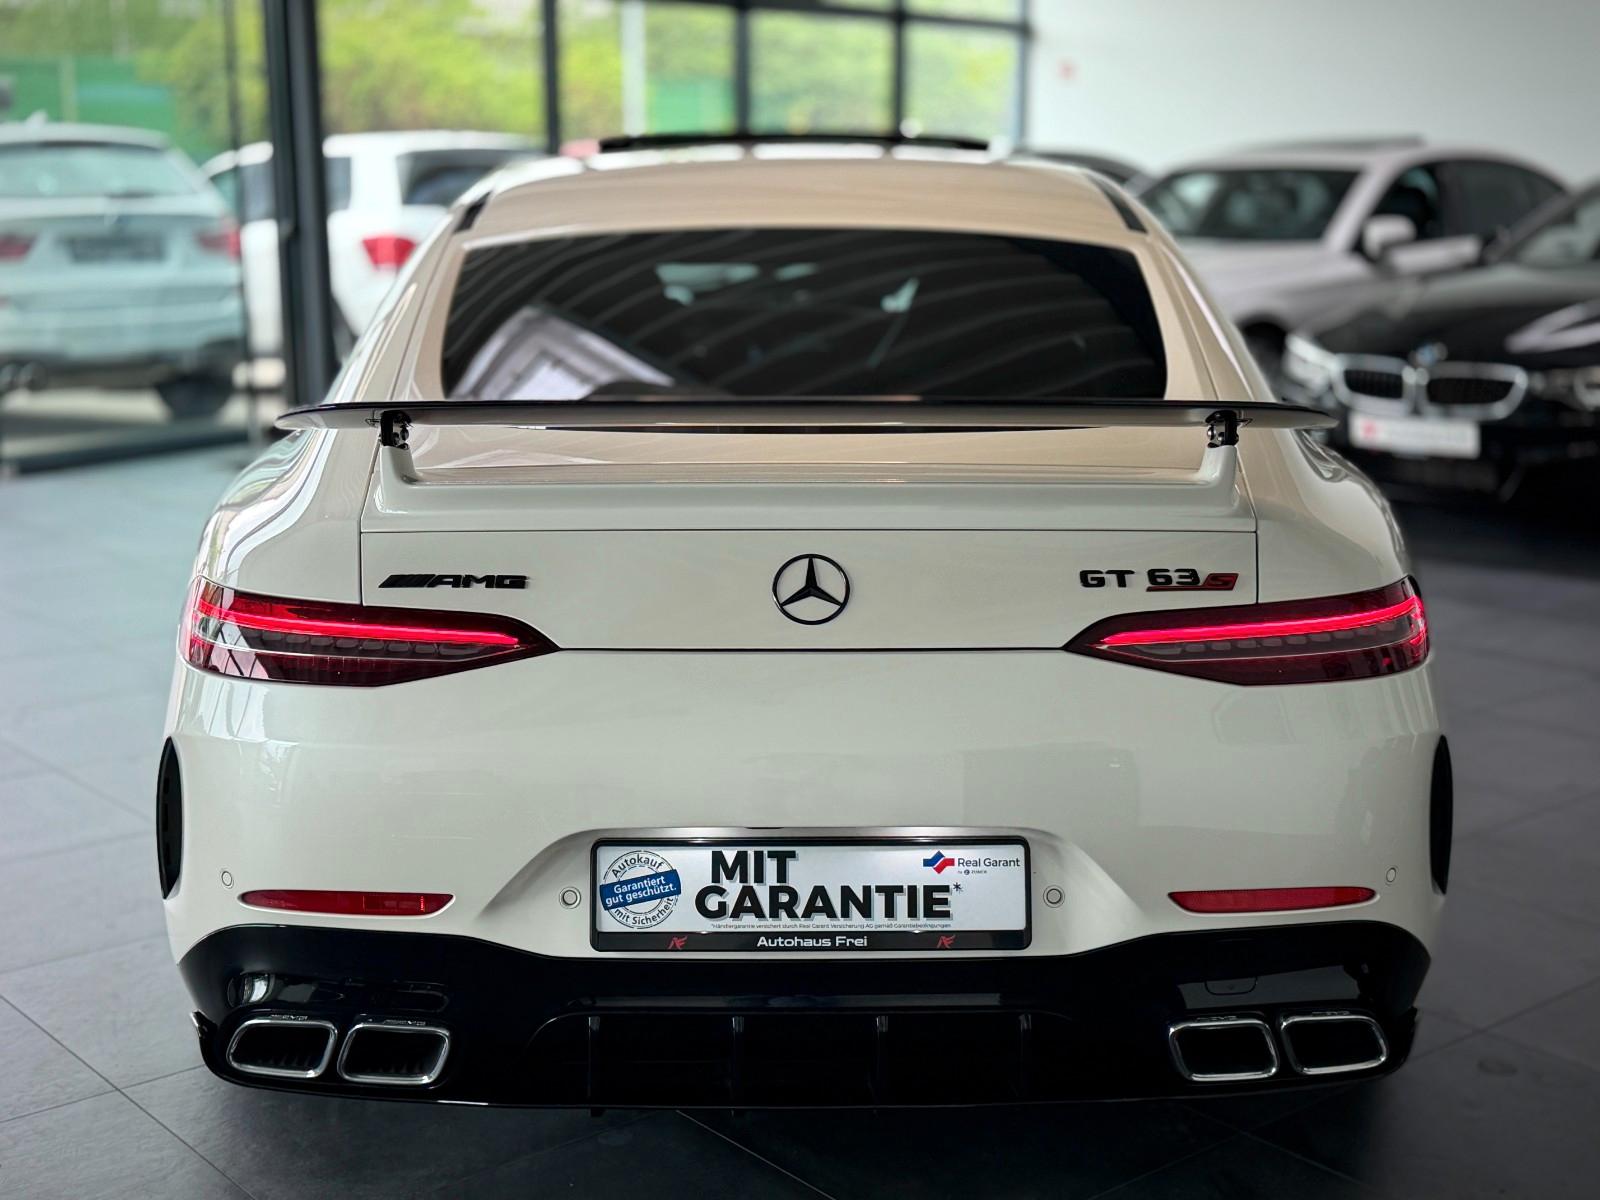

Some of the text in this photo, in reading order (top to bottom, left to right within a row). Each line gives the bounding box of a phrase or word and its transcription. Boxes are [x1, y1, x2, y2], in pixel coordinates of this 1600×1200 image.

[426, 573, 528, 589] AMG
[1079, 569, 1135, 588] GT
[611, 853, 665, 879] Autokauf
[711, 850, 798, 885] MIT
[957, 857, 1021, 868] Real Garant
[613, 874, 666, 894] Garantiert
[605, 894, 624, 907] gut
[613, 897, 675, 926] mit Sicherheit
[756, 935, 868, 947] Autohaus Frei
